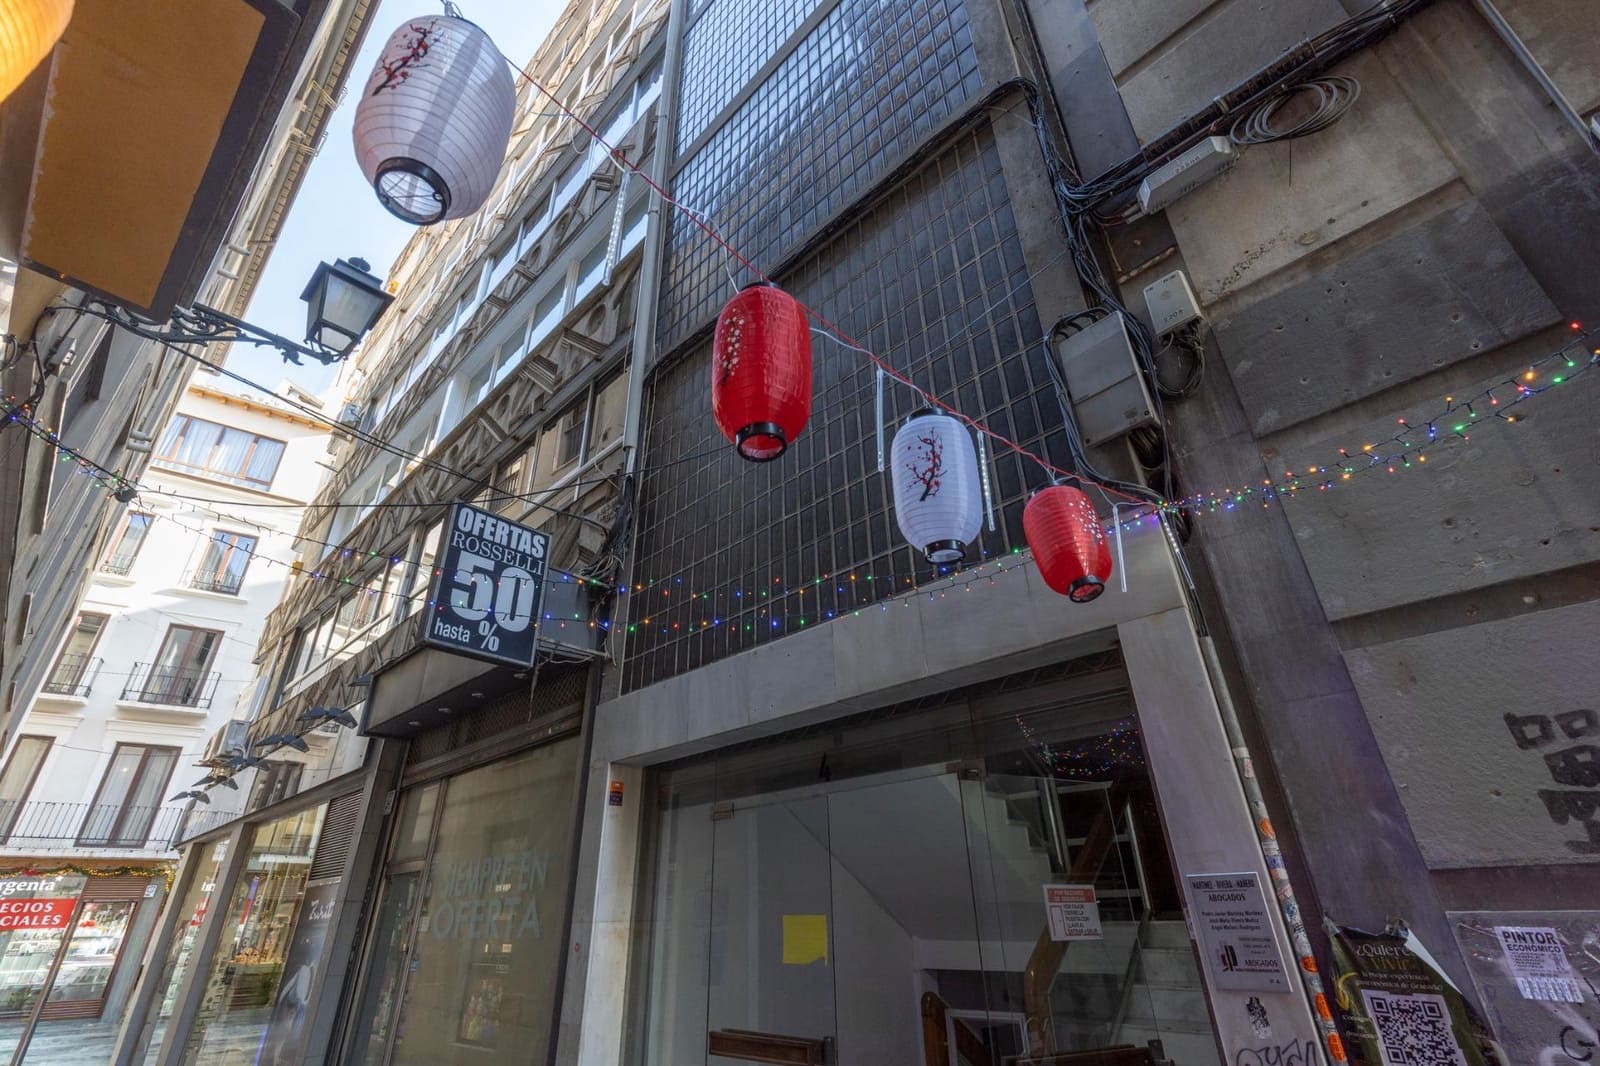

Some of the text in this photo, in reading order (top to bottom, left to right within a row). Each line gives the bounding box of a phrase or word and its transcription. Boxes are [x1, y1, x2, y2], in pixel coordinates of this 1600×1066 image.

[458, 507, 545, 559] OFERTAS
[452, 530, 545, 576] ROSSELLI
[450, 550, 535, 633] 50
[434, 617, 500, 652] hasta %
[0, 879, 56, 896] rgenta
[1208, 893, 1246, 903] ABOGADOS
[0, 902, 54, 913] ECIOS
[0, 914, 61, 926] CIALES
[432, 895, 544, 940] OFERTA
[1502, 930, 1558, 945] PINTOR
